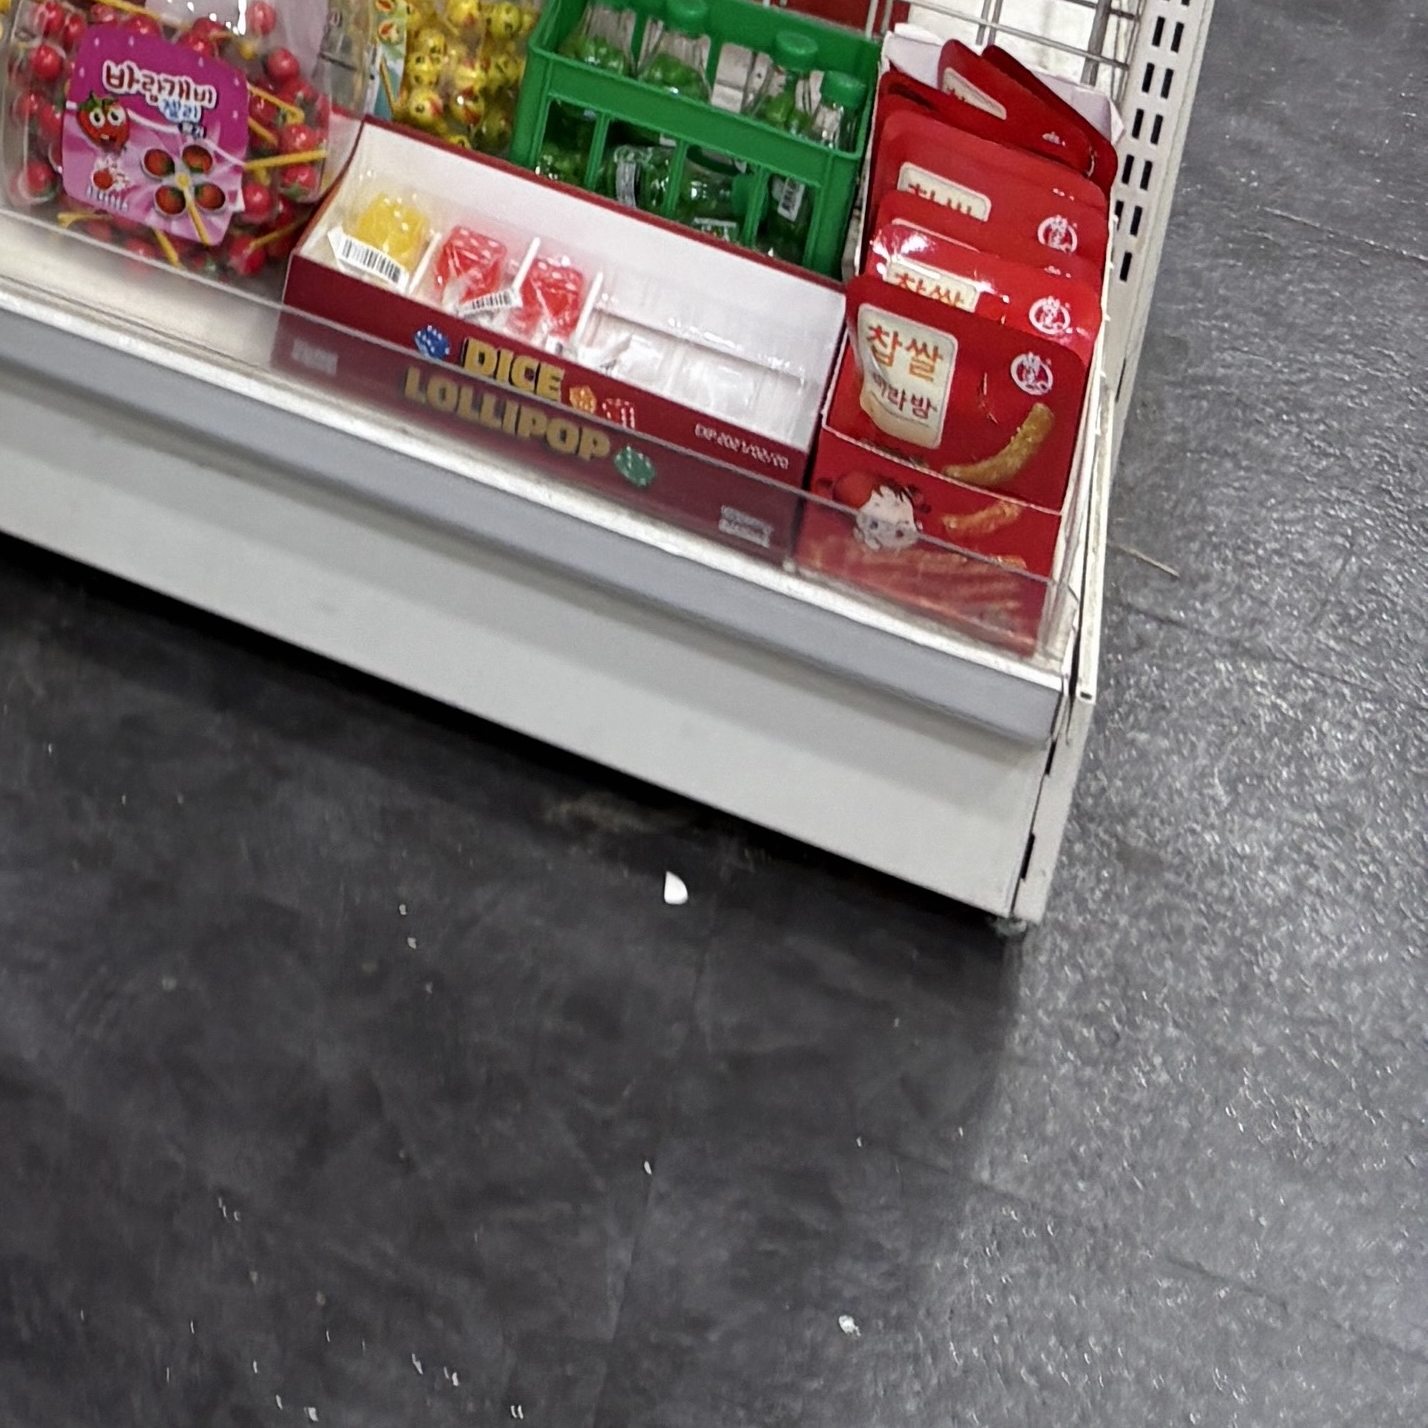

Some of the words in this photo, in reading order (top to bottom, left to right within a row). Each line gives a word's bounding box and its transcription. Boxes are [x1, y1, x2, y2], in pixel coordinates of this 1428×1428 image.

[103, 61, 218, 110] 바람개비
[464, 337, 565, 397] DICE
[866, 325, 944, 384] 찹쌀
[405, 366, 612, 462] LOLLIPOP
